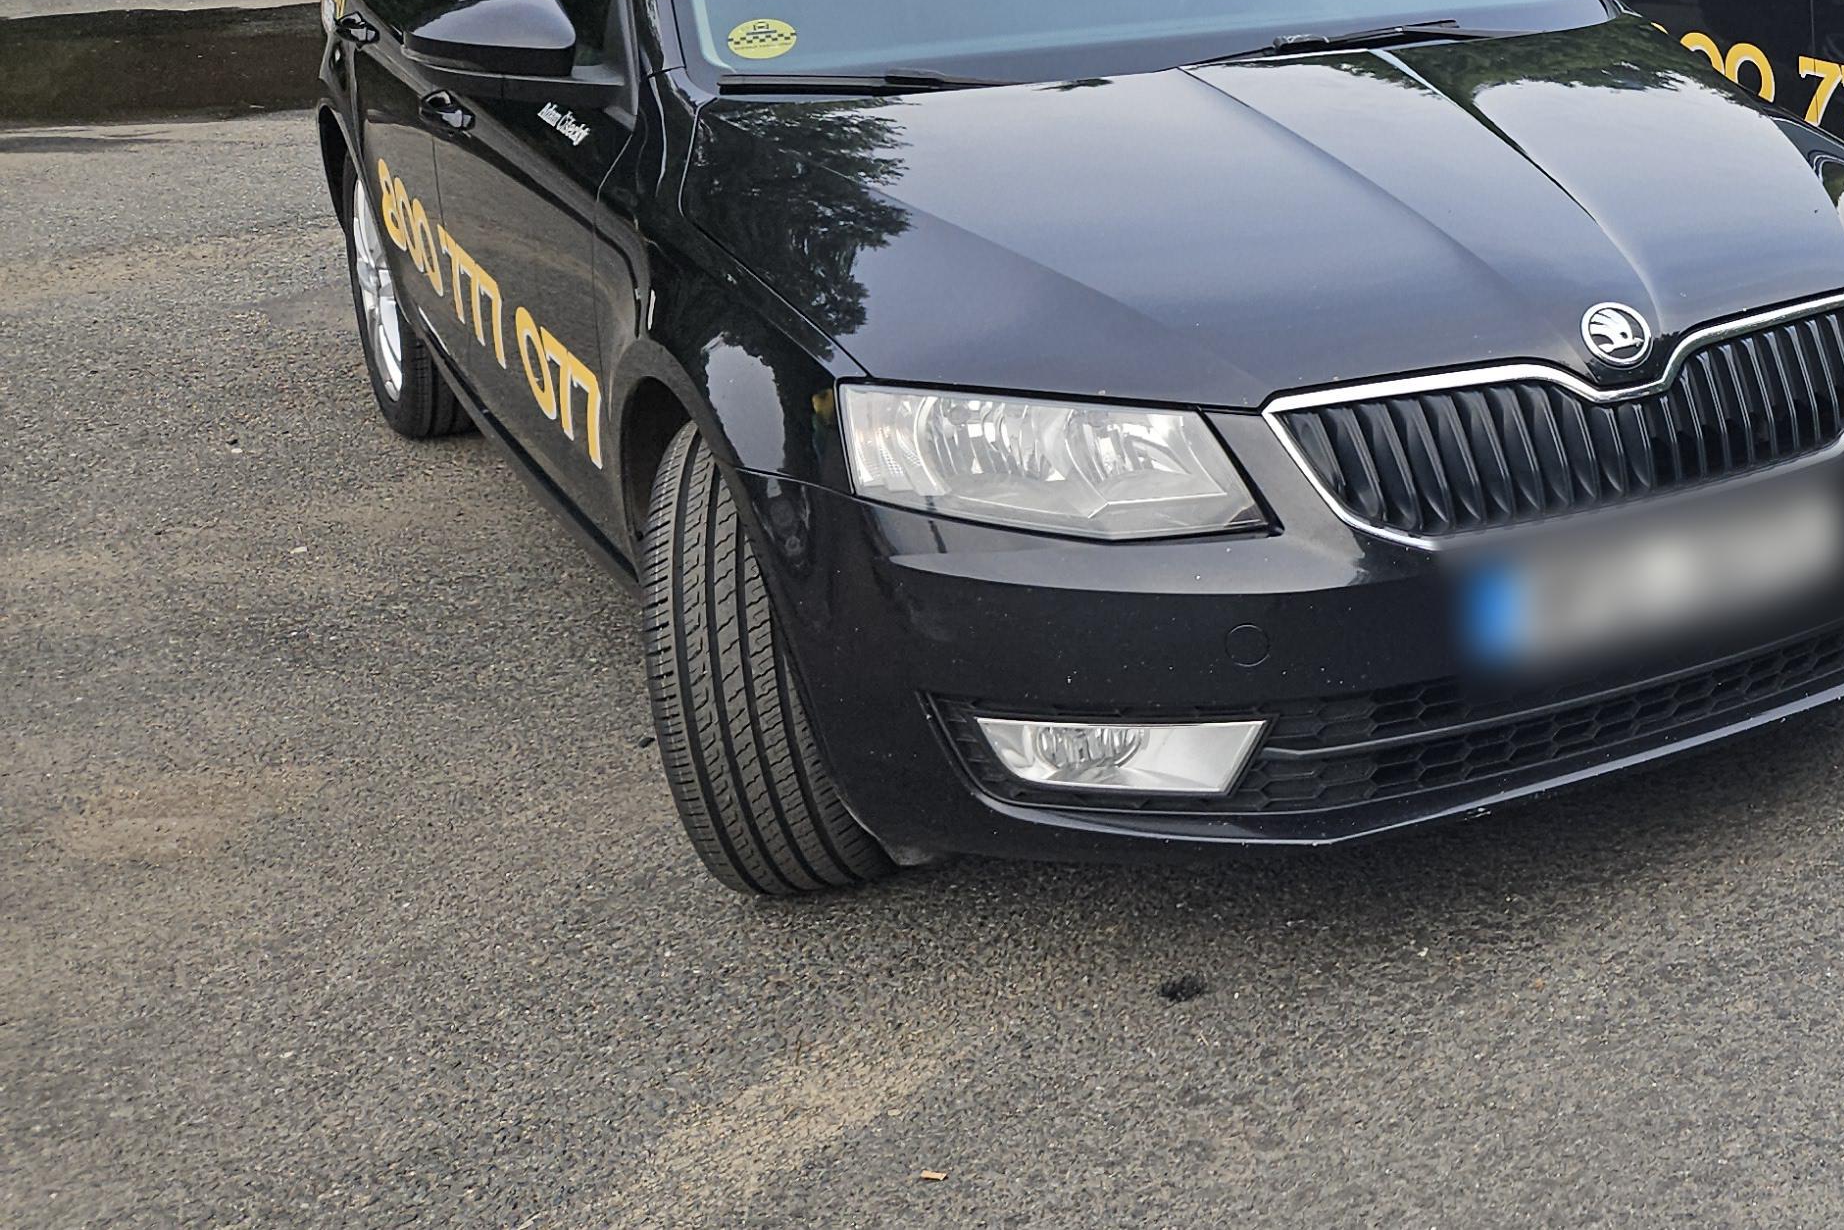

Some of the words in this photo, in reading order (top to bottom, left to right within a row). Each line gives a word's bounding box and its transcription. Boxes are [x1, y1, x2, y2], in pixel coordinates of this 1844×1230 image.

[378, 158, 444, 297] 800
[437, 224, 506, 370] 777
[515, 306, 603, 469] 077
